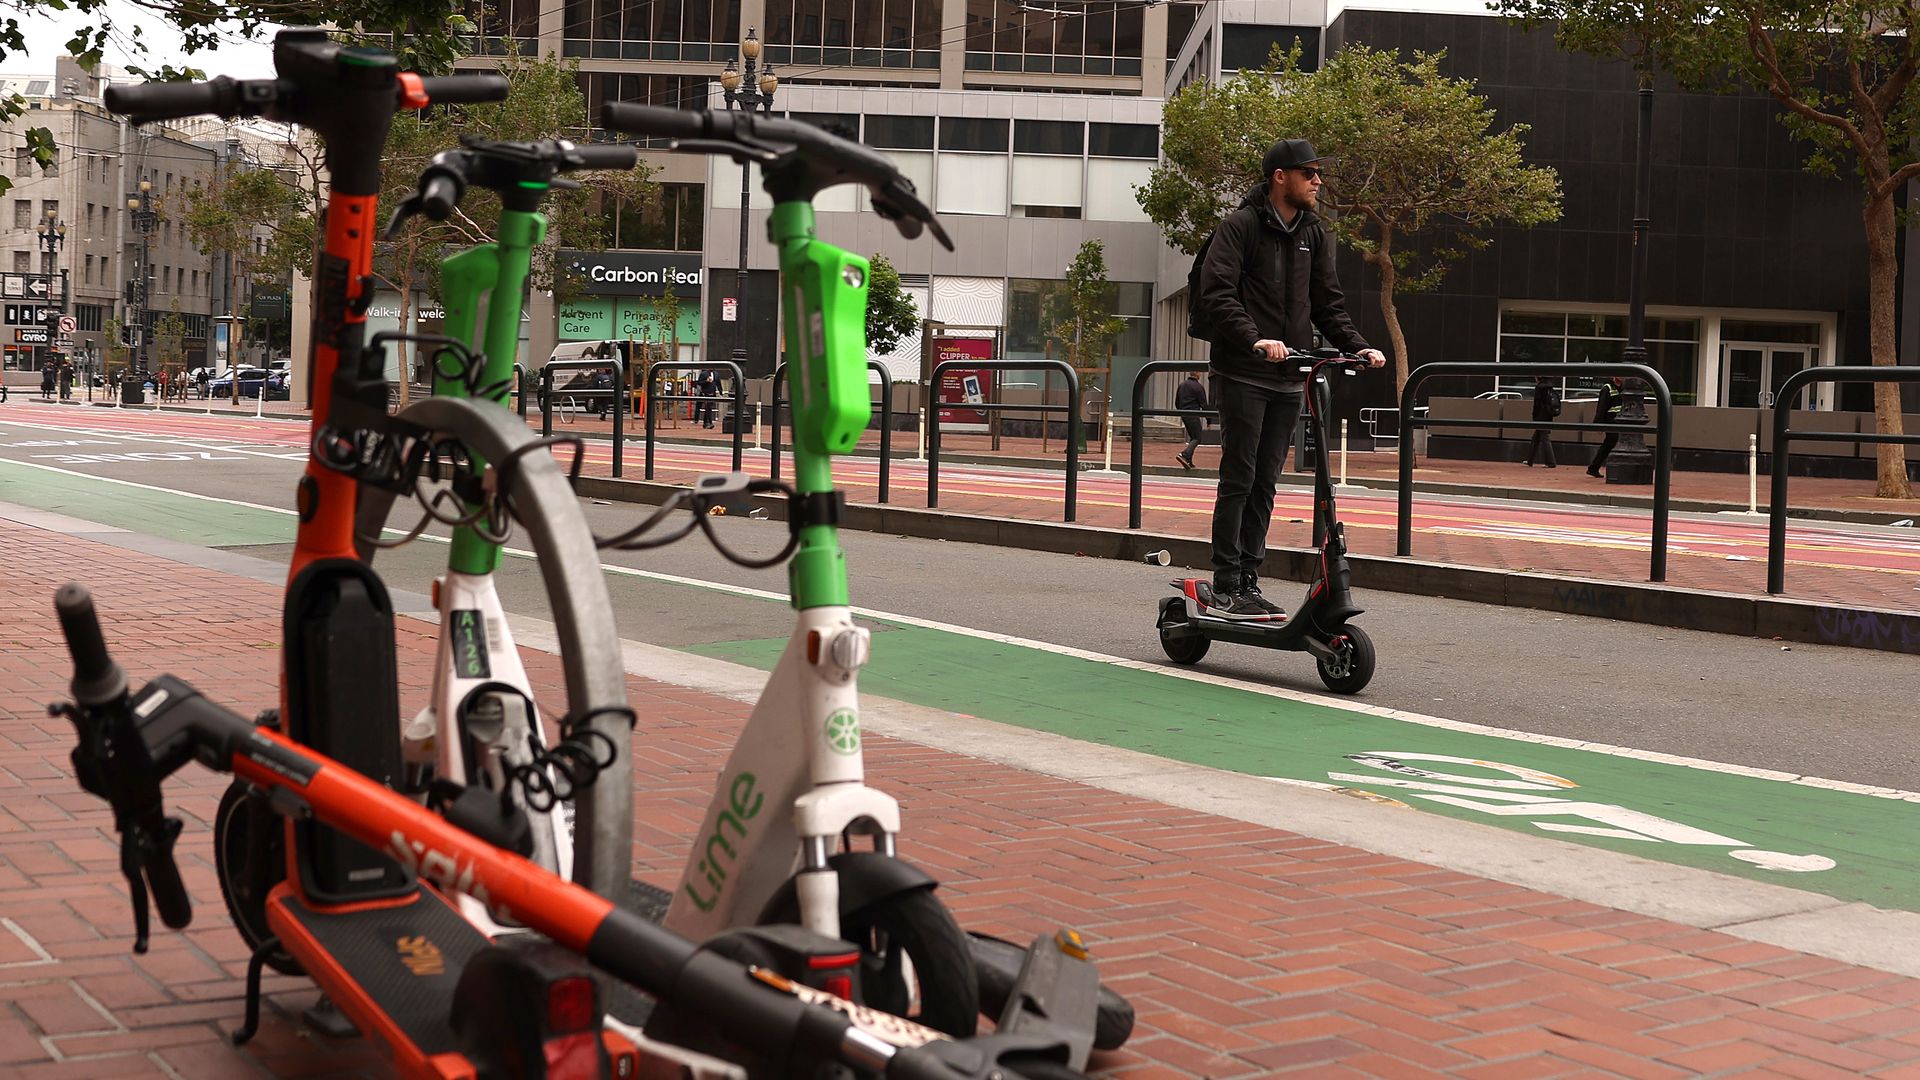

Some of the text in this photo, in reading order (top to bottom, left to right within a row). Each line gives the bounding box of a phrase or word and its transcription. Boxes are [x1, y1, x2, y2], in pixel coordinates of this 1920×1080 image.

[591, 265, 658, 282] Carbon
[564, 322, 590, 332] Care
[623, 324, 651, 334] Care
[22, 334, 48, 342] GYRO
[30, 451, 249, 464] ZONE
[461, 611, 480, 676] A126
[685, 772, 764, 912] Lime
